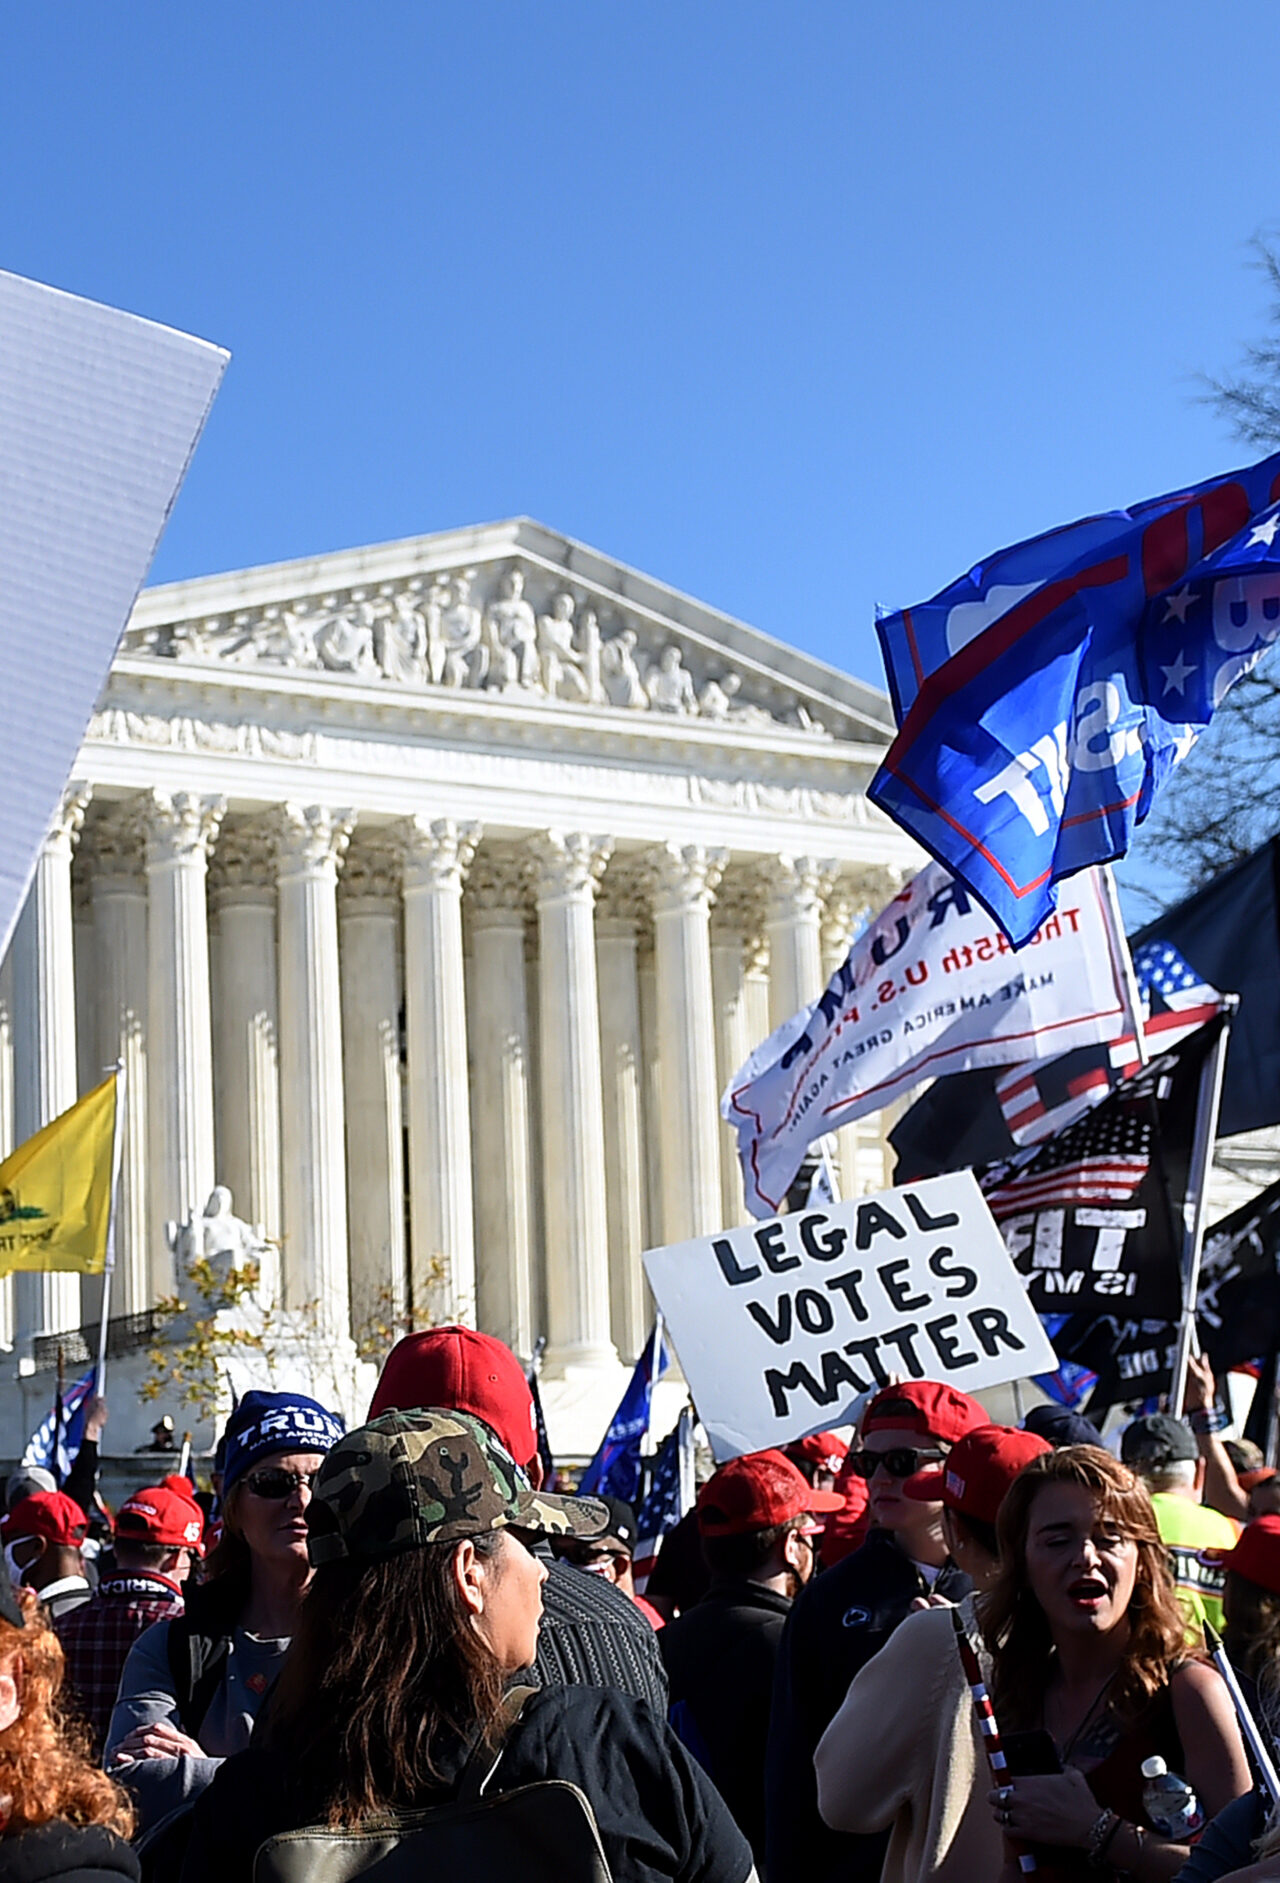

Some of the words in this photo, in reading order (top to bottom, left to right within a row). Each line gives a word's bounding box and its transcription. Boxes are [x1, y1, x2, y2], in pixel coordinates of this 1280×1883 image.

[712, 1193, 959, 1287] LEGAL
[746, 1247, 977, 1345] VOTES
[764, 1308, 1025, 1418] MATTER
[237, 1412, 345, 1447] TRUM
